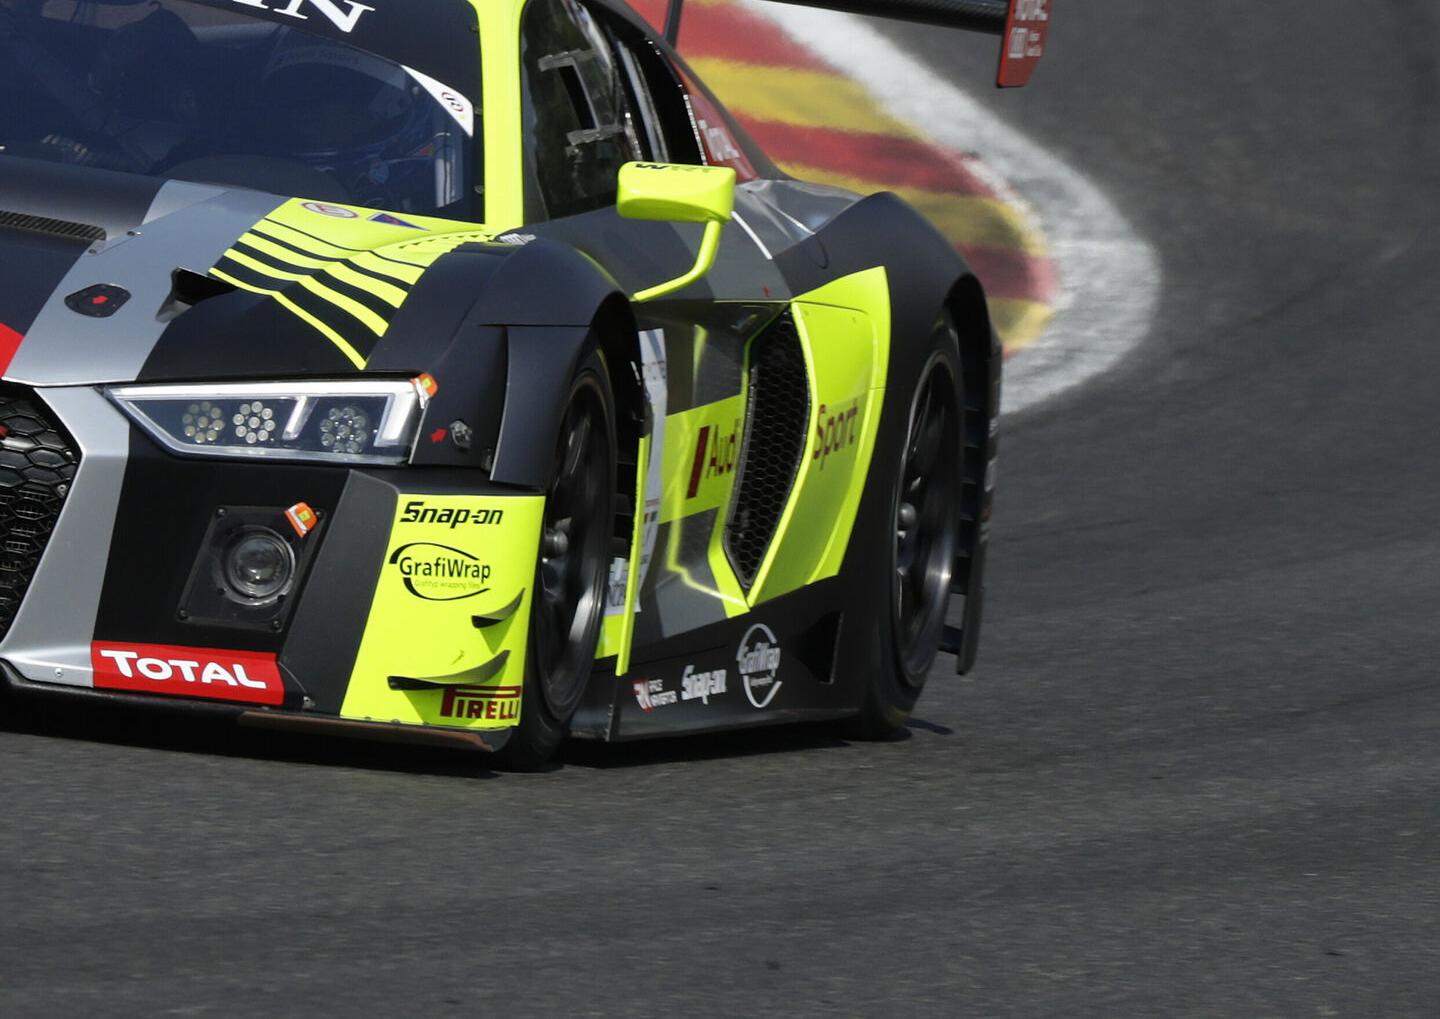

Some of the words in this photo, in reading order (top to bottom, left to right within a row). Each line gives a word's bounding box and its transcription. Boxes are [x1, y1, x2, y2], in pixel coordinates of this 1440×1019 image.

[813, 398, 858, 471] Sport
[399, 501, 504, 529] Snap-on
[399, 556, 491, 584] GrafiWrap
[100, 649, 267, 690] TOTAL
[440, 685, 522, 719] PIRELLI
